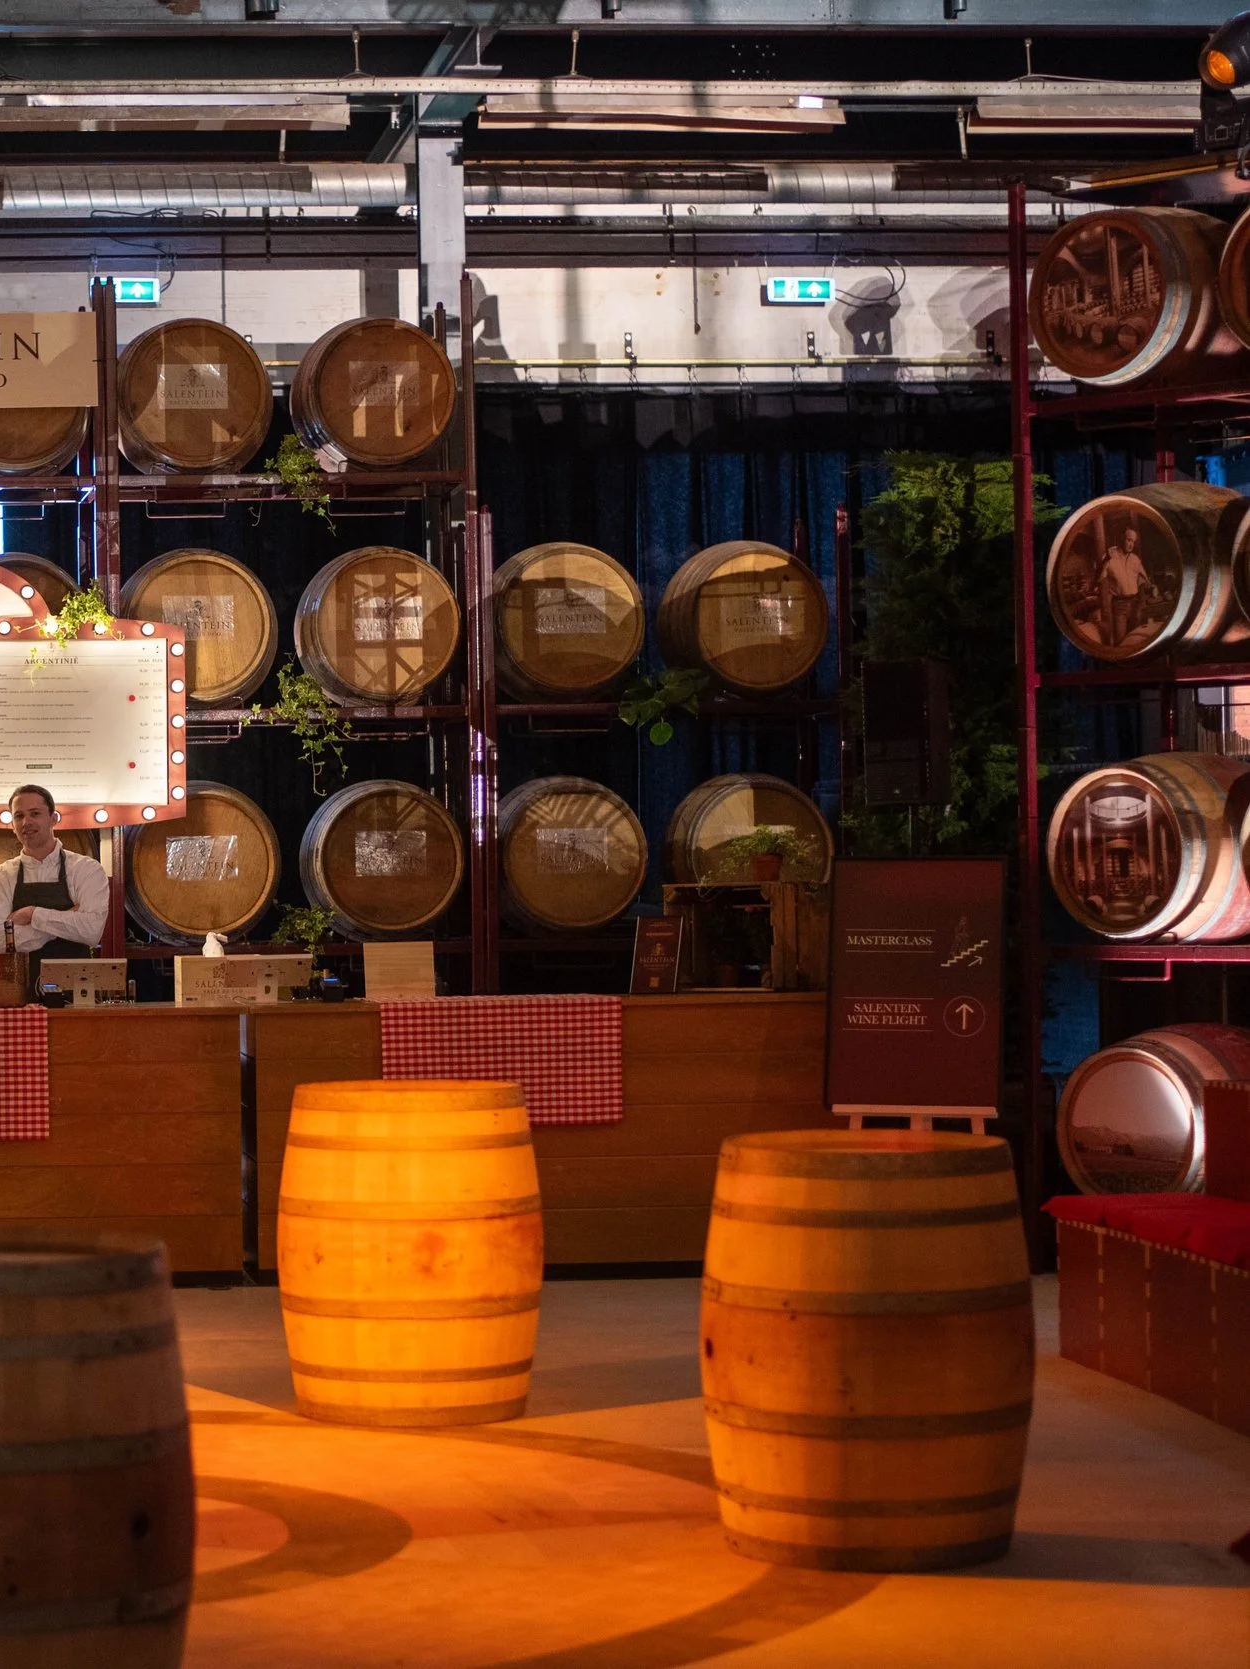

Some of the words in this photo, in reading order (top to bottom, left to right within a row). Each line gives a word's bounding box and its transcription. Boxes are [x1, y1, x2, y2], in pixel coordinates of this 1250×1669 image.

[161, 389, 224, 399] SALENTEIN
[539, 613, 603, 623] SALENTEIN
[847, 935, 933, 946] MASTERCLASS
[853, 1003, 921, 1013] SALENTEIN
[847, 1014, 879, 1025] WINE
[882, 1015, 928, 1026] FLIGHT
